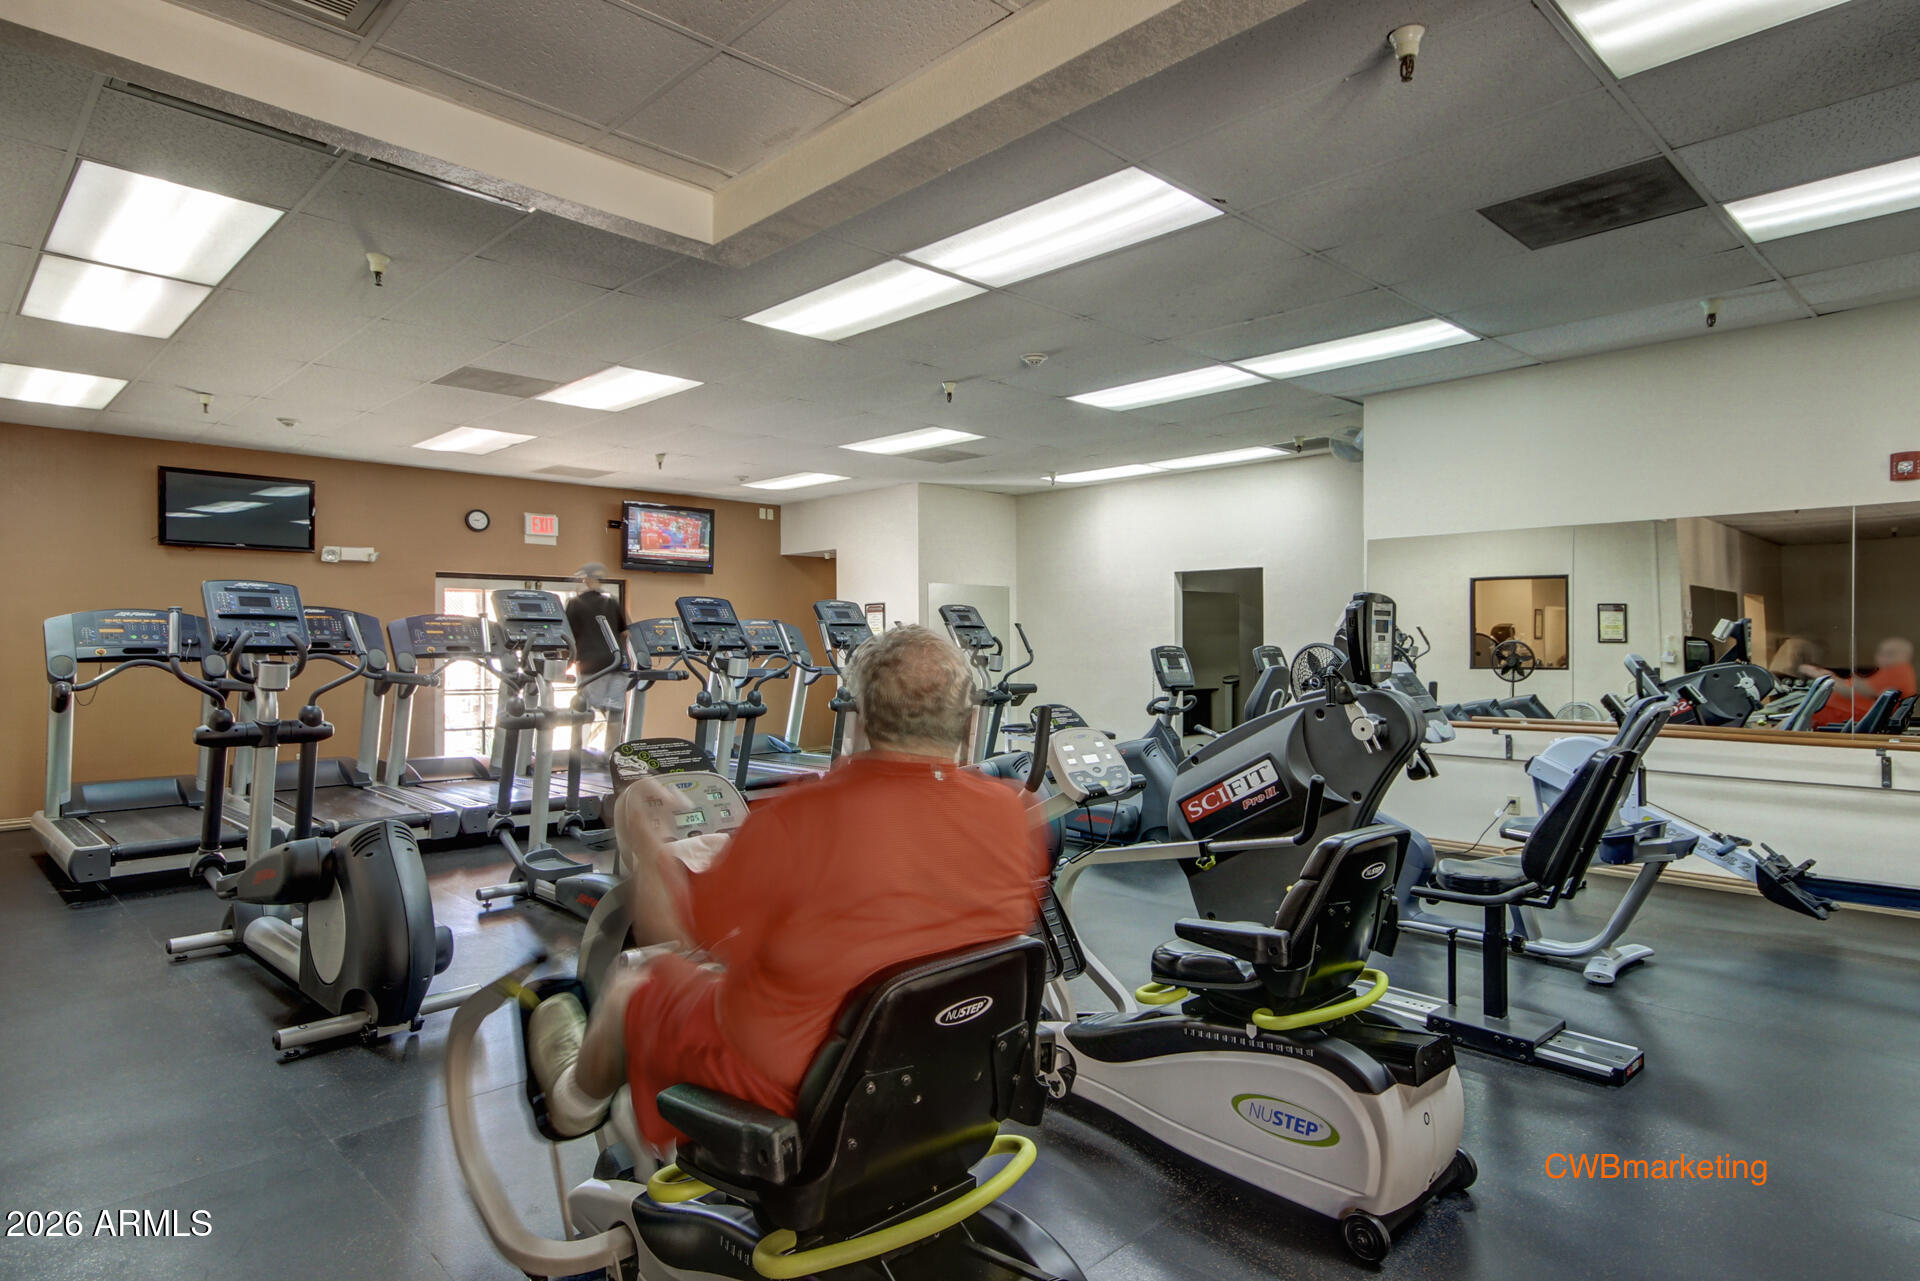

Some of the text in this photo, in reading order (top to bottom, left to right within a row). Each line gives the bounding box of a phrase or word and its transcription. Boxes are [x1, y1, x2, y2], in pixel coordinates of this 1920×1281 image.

[532, 516, 555, 534] EXIT
[1188, 766, 1267, 818] SCIFIT
[1242, 794, 1265, 810] Pro
[945, 1001, 984, 1022] NUSTEP
[1248, 1102, 1318, 1136] NUSTEP
